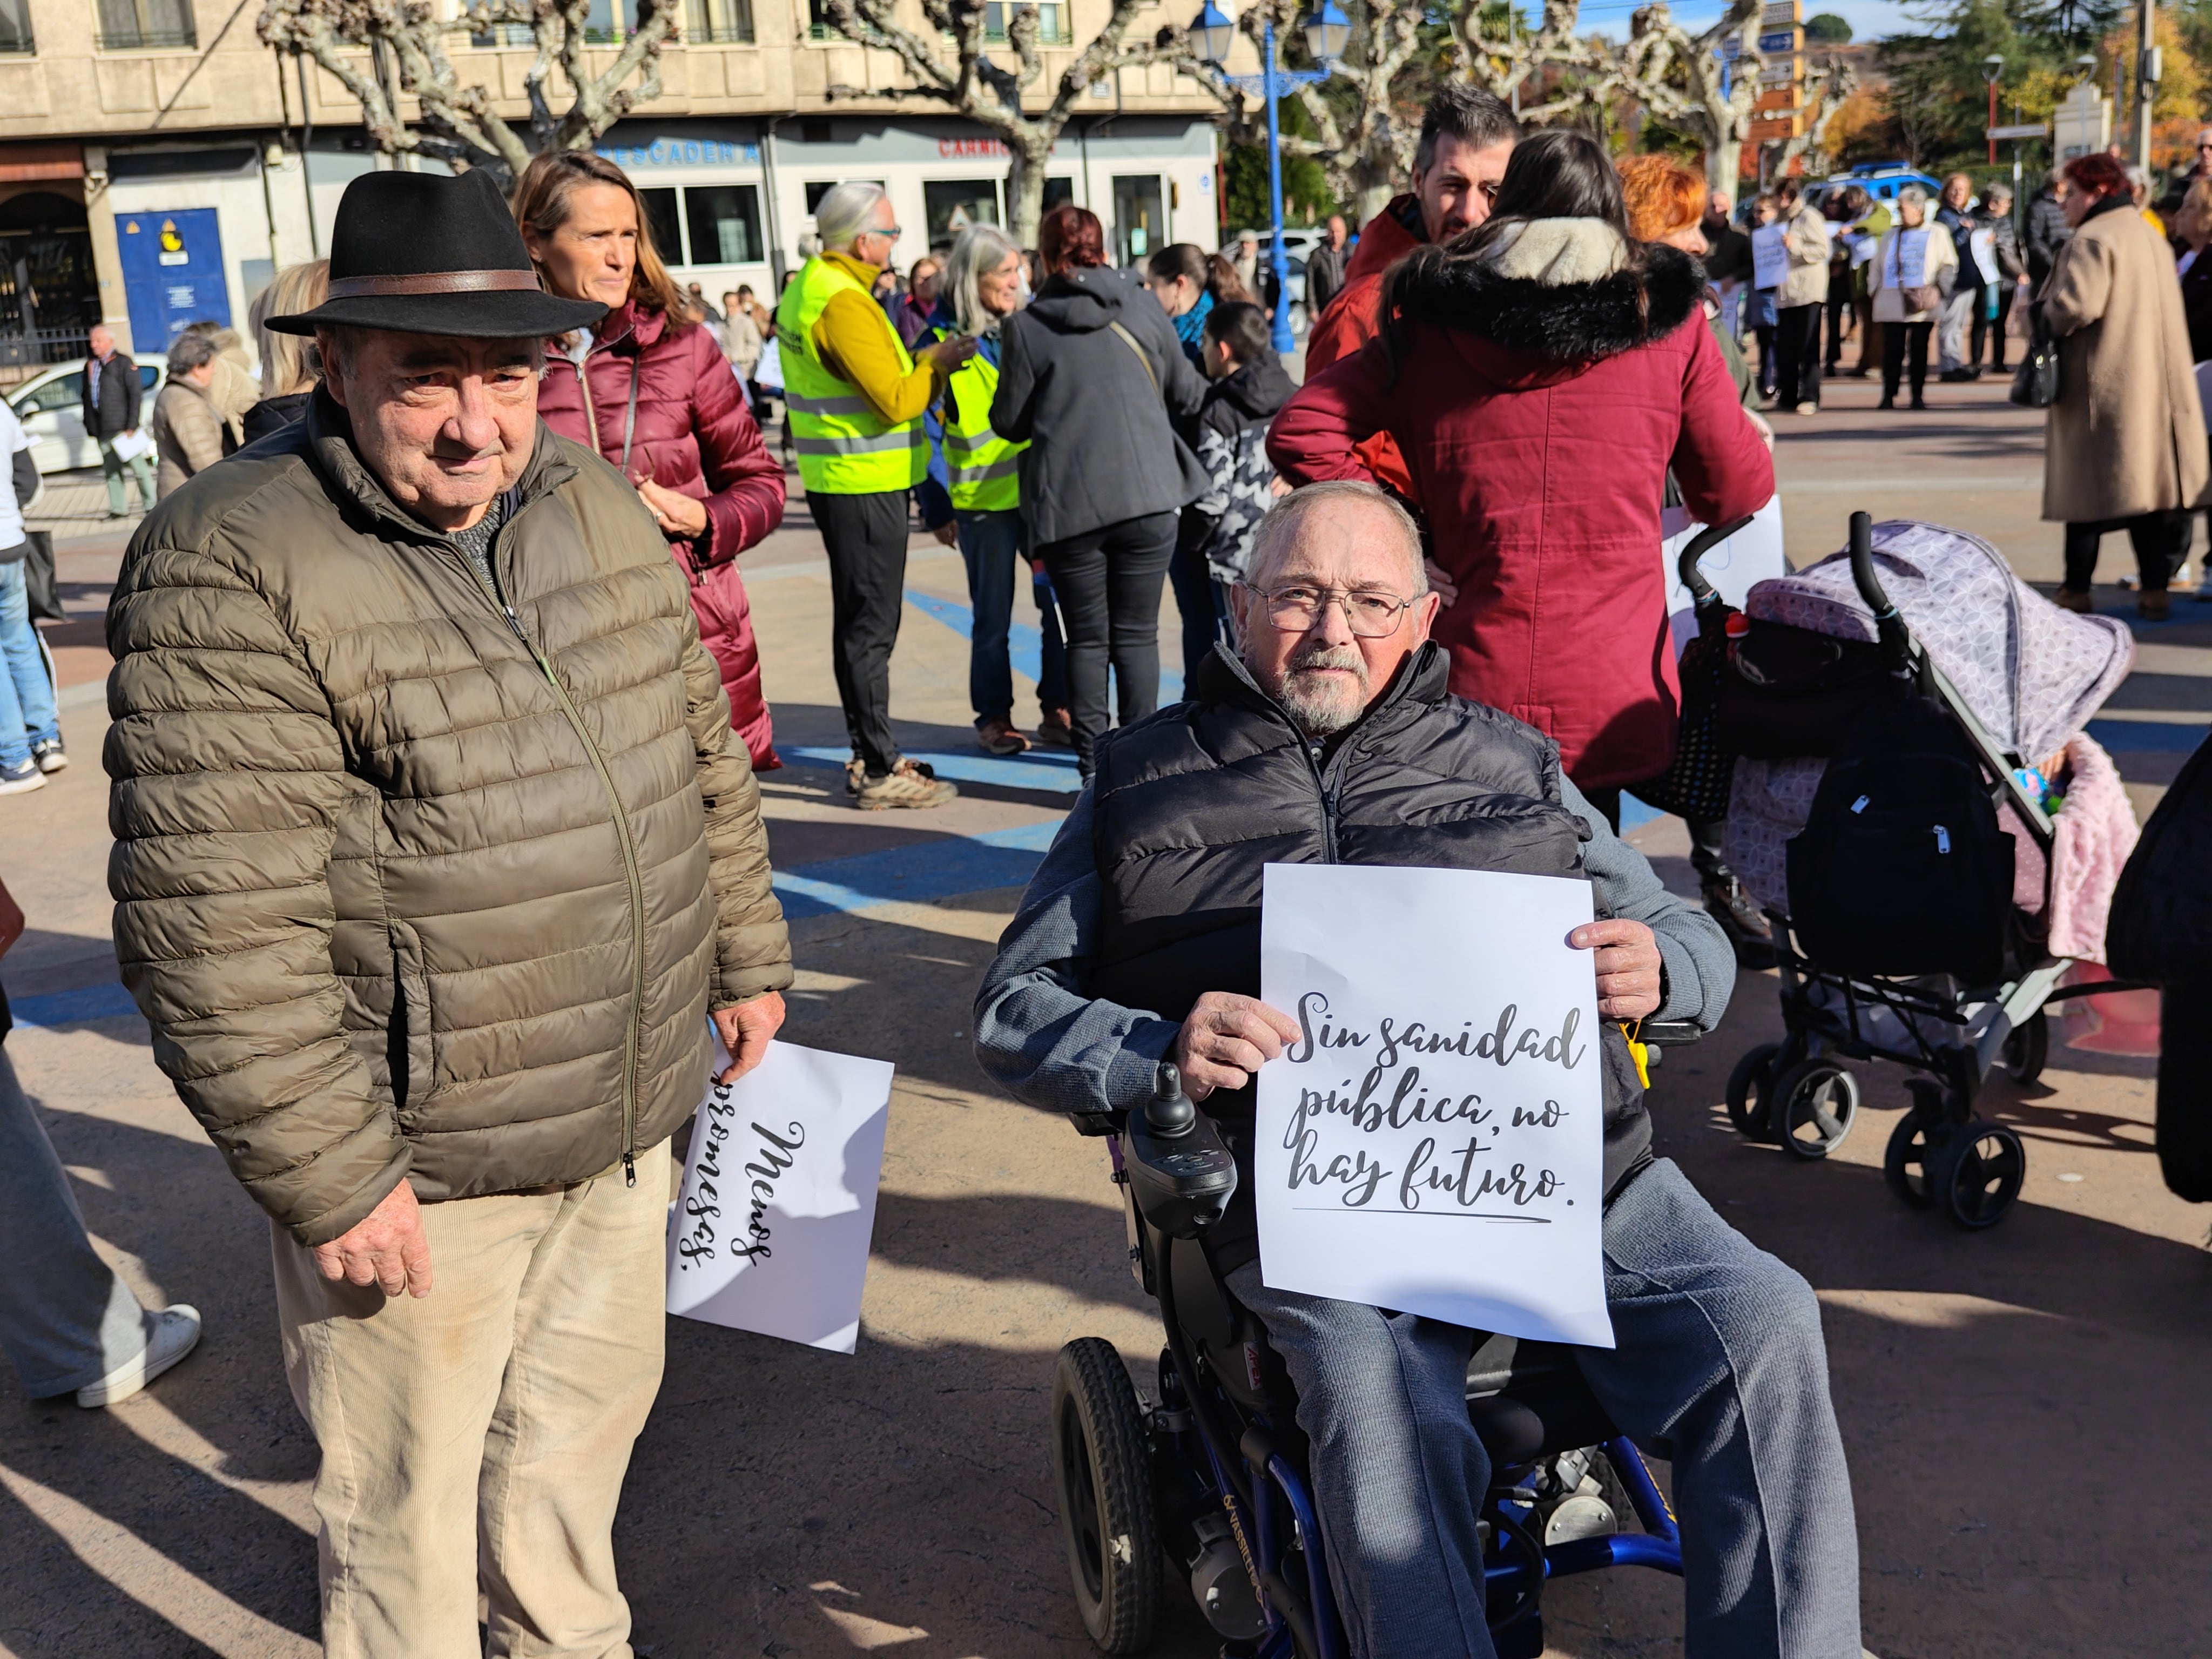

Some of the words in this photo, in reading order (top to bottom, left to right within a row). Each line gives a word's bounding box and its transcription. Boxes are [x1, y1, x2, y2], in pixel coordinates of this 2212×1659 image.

[1287, 992, 1371, 1063] Sin
[1377, 1003, 1587, 1070] sanidad
[1283, 1066, 1500, 1149] pública,
[1512, 1100, 1570, 1128] no
[679, 1071, 736, 1272] promesas,
[730, 1121, 805, 1267] Menos
[1288, 1129, 1393, 1207] hay
[1400, 1136, 1574, 1210] futuro.
